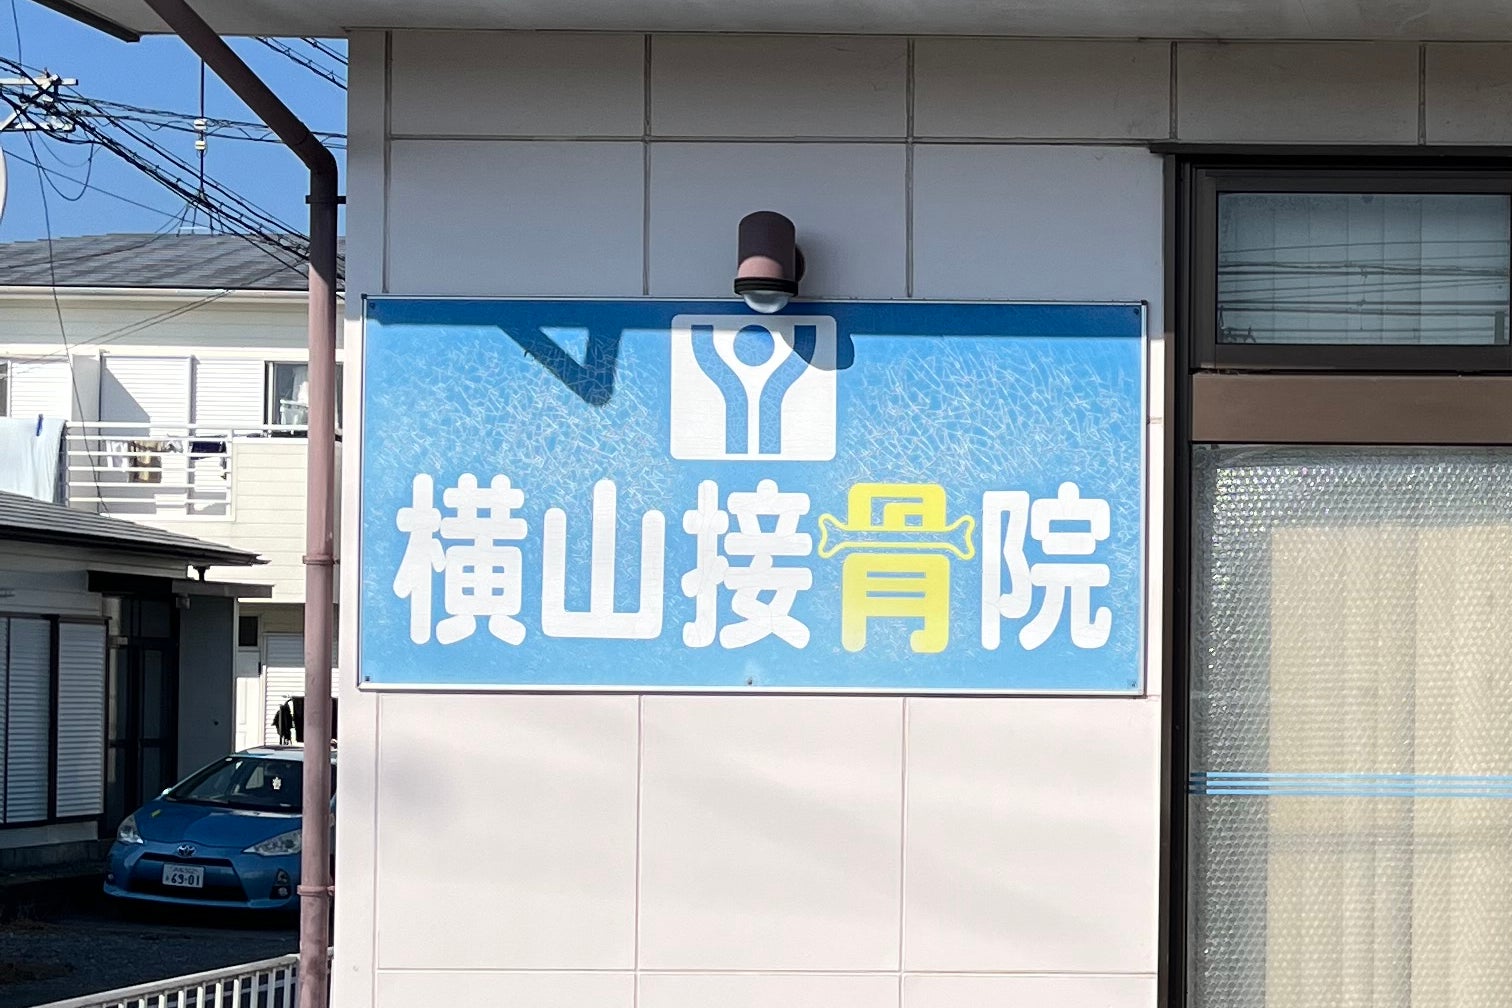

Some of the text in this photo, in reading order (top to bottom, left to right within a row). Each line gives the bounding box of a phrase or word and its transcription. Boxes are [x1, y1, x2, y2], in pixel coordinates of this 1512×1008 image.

[393, 472, 1113, 654] 横山接骨院
